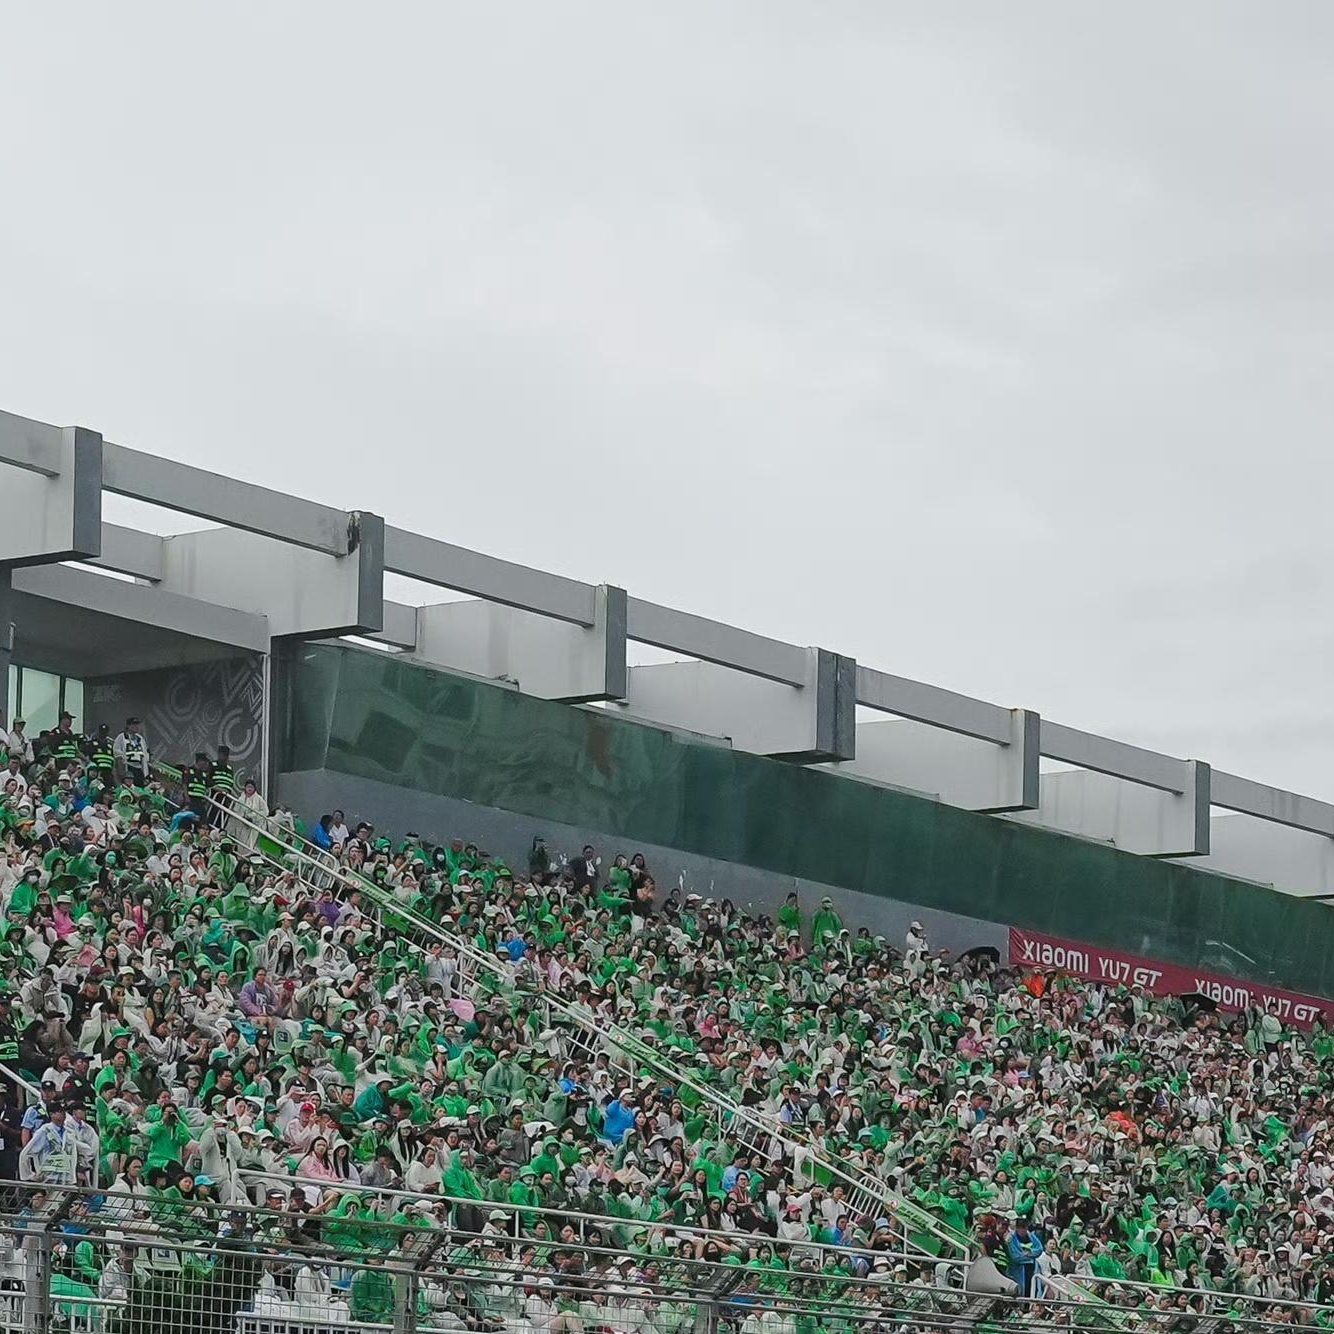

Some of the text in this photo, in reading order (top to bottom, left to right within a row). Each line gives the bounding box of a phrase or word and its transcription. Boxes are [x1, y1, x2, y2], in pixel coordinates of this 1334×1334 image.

[1099, 957, 1131, 981] YU7
[1133, 968, 1163, 988] GT
[1293, 1004, 1319, 1023] GT
